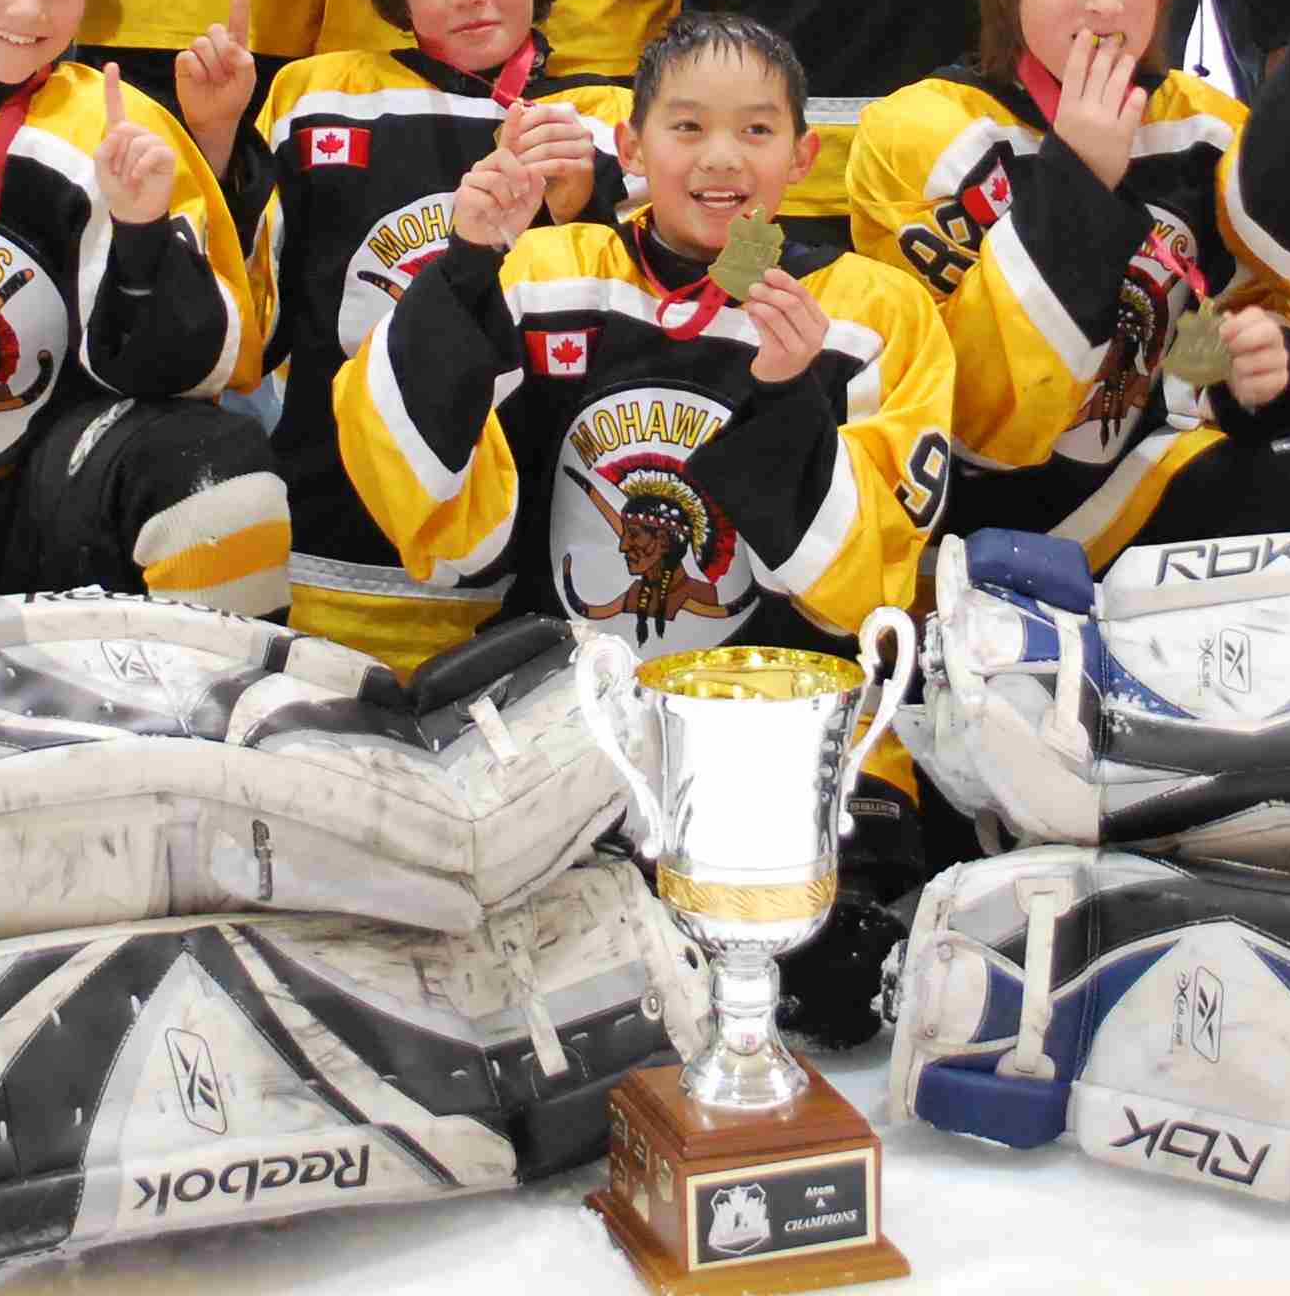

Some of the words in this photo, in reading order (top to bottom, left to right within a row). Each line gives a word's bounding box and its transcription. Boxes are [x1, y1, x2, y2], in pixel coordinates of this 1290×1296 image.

[570, 400, 723, 471] MOHAW
[893, 429, 950, 530] 9
[133, 1143, 371, 1218] Reebok
[805, 1183, 836, 1198] Atom
[784, 1209, 858, 1232] CHAMPIONS
